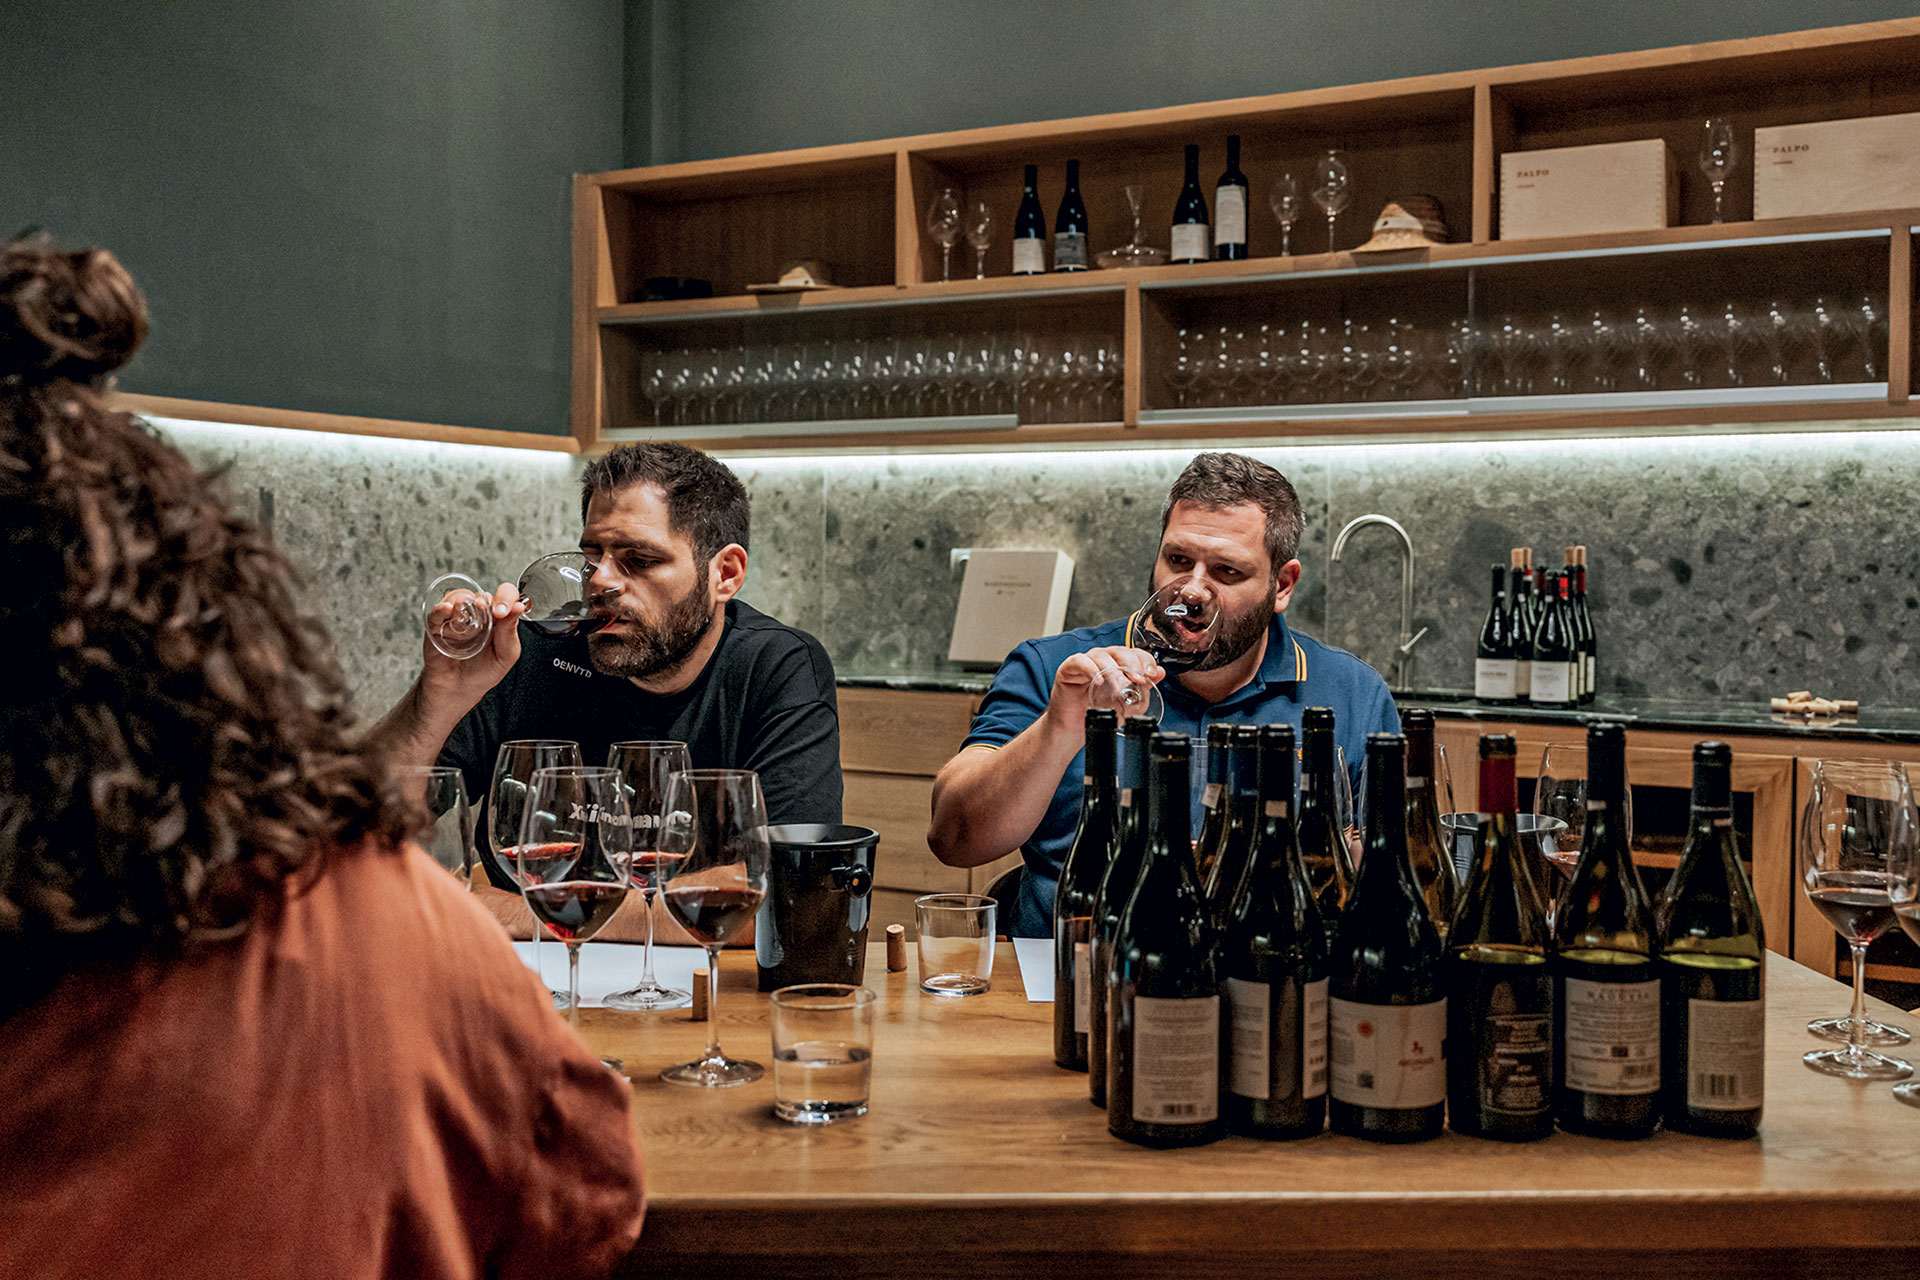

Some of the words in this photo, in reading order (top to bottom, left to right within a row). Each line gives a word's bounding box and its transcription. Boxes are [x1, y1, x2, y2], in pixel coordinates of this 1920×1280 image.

[1773, 143, 1810, 153] PALPO
[1516, 168, 1550, 178] PALPO
[552, 657, 593, 679] OENVTD
